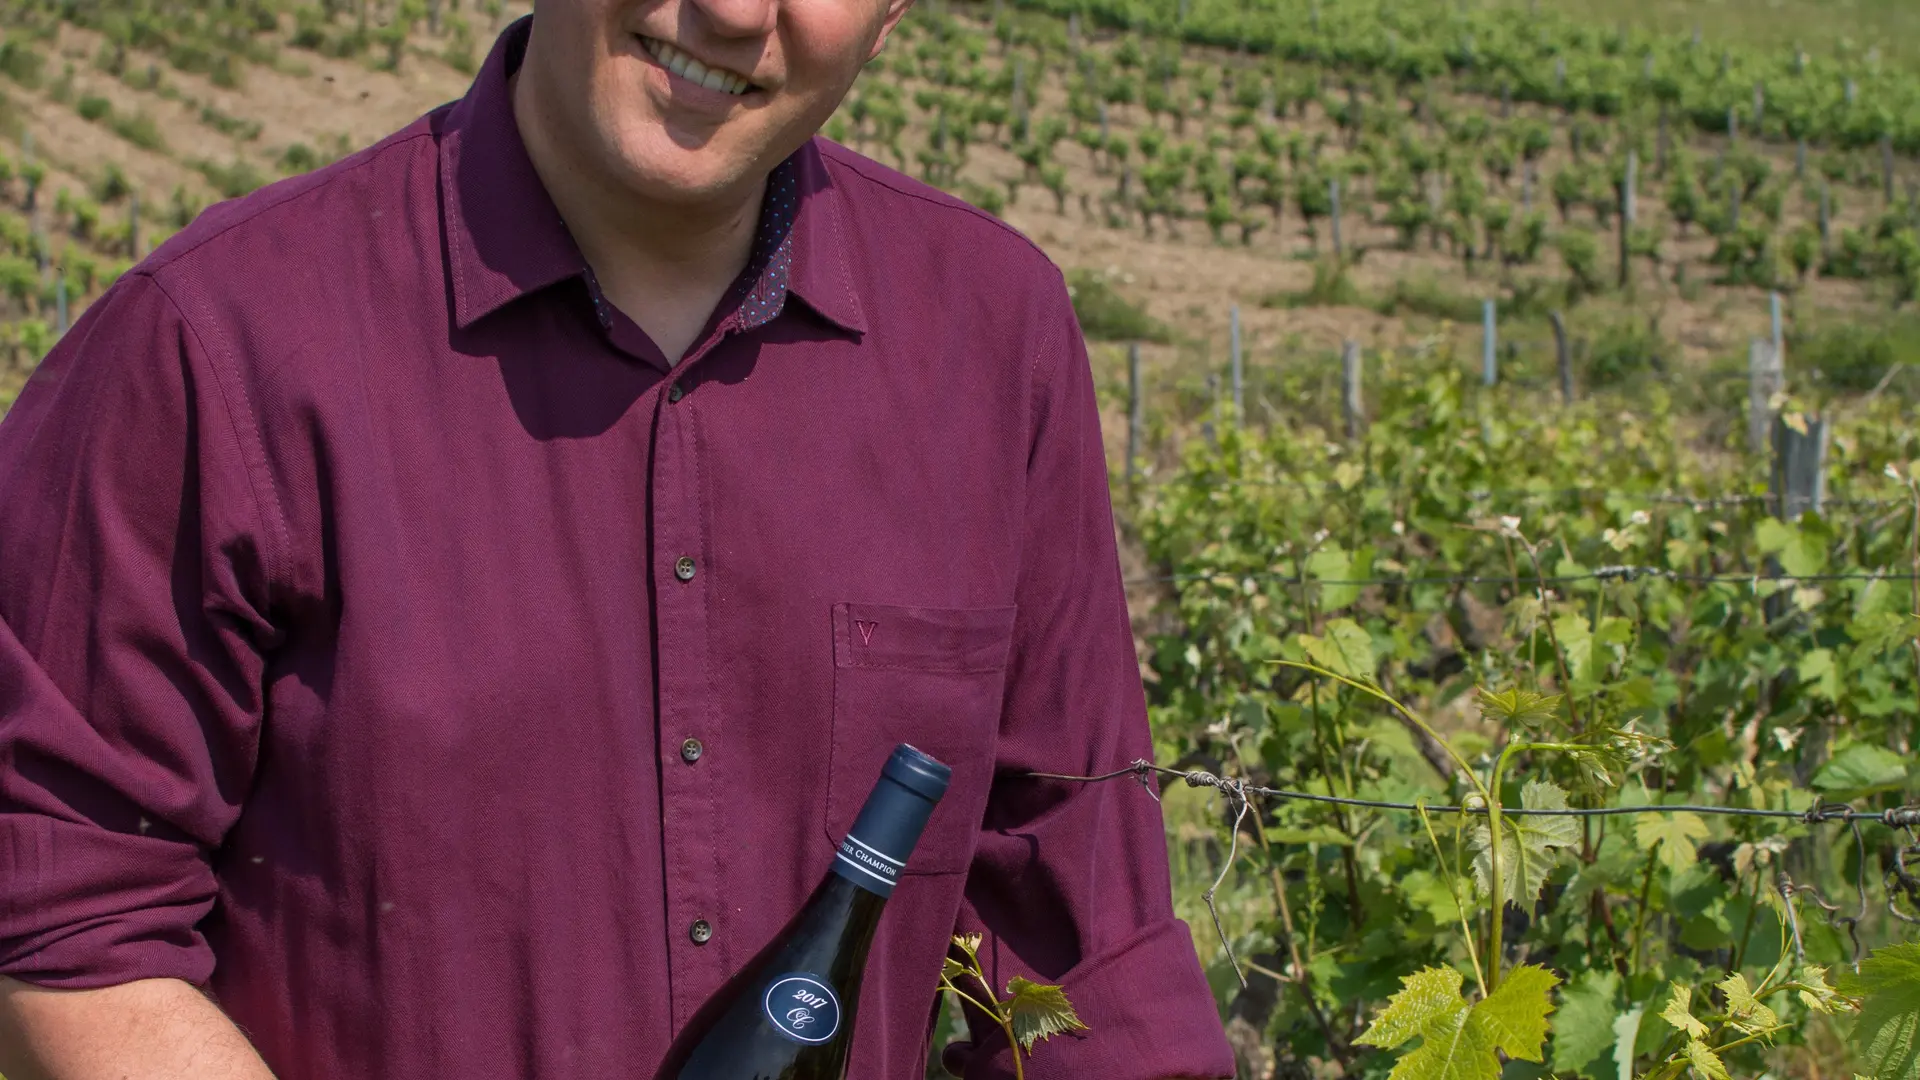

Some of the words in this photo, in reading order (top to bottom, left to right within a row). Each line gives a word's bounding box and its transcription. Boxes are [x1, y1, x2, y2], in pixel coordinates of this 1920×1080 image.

[854, 619, 878, 646] V
[855, 849, 897, 876] CHAMPION
[792, 989, 828, 1009] 2017
